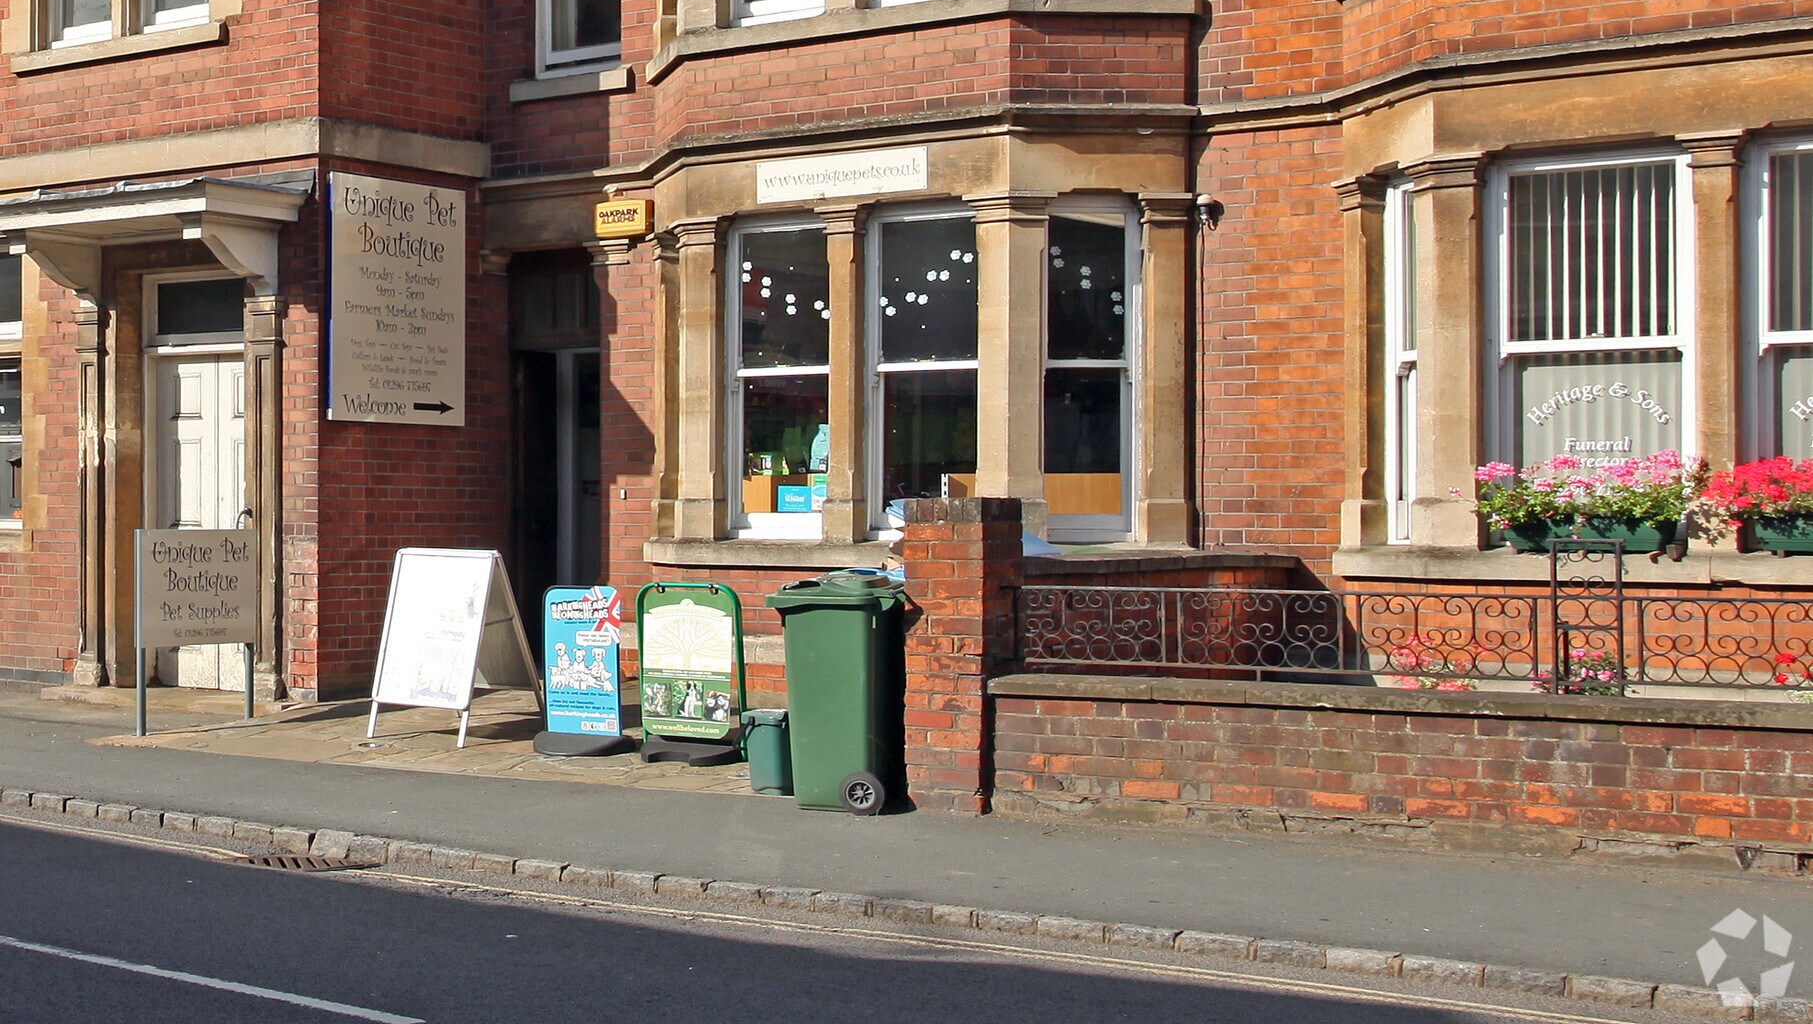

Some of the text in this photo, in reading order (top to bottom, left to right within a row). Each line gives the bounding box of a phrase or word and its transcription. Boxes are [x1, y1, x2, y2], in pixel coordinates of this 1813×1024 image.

[763, 158, 921, 186] www.uniquepets.co.uk
[344, 187, 457, 227] Unique Pet
[599, 208, 639, 218] OAKPARK
[601, 216, 635, 224] ALARMS
[358, 221, 445, 267] Boutique
[359, 266, 394, 284] Monday
[405, 271, 440, 289] Saturday
[376, 285, 395, 298] 9am
[405, 287, 425, 303] 5pm
[344, 300, 455, 324] Farmers Market Sundays
[375, 319, 397, 333] 10am
[408, 322, 427, 338] 3pm
[343, 392, 407, 416] Welcome
[1526, 381, 1671, 426] Heritage & Sons
[1563, 436, 1630, 451] Funeral
[152, 537, 249, 568] Unique Pet
[164, 567, 238, 596] Boutique
[160, 600, 240, 624] Pet Supplies
